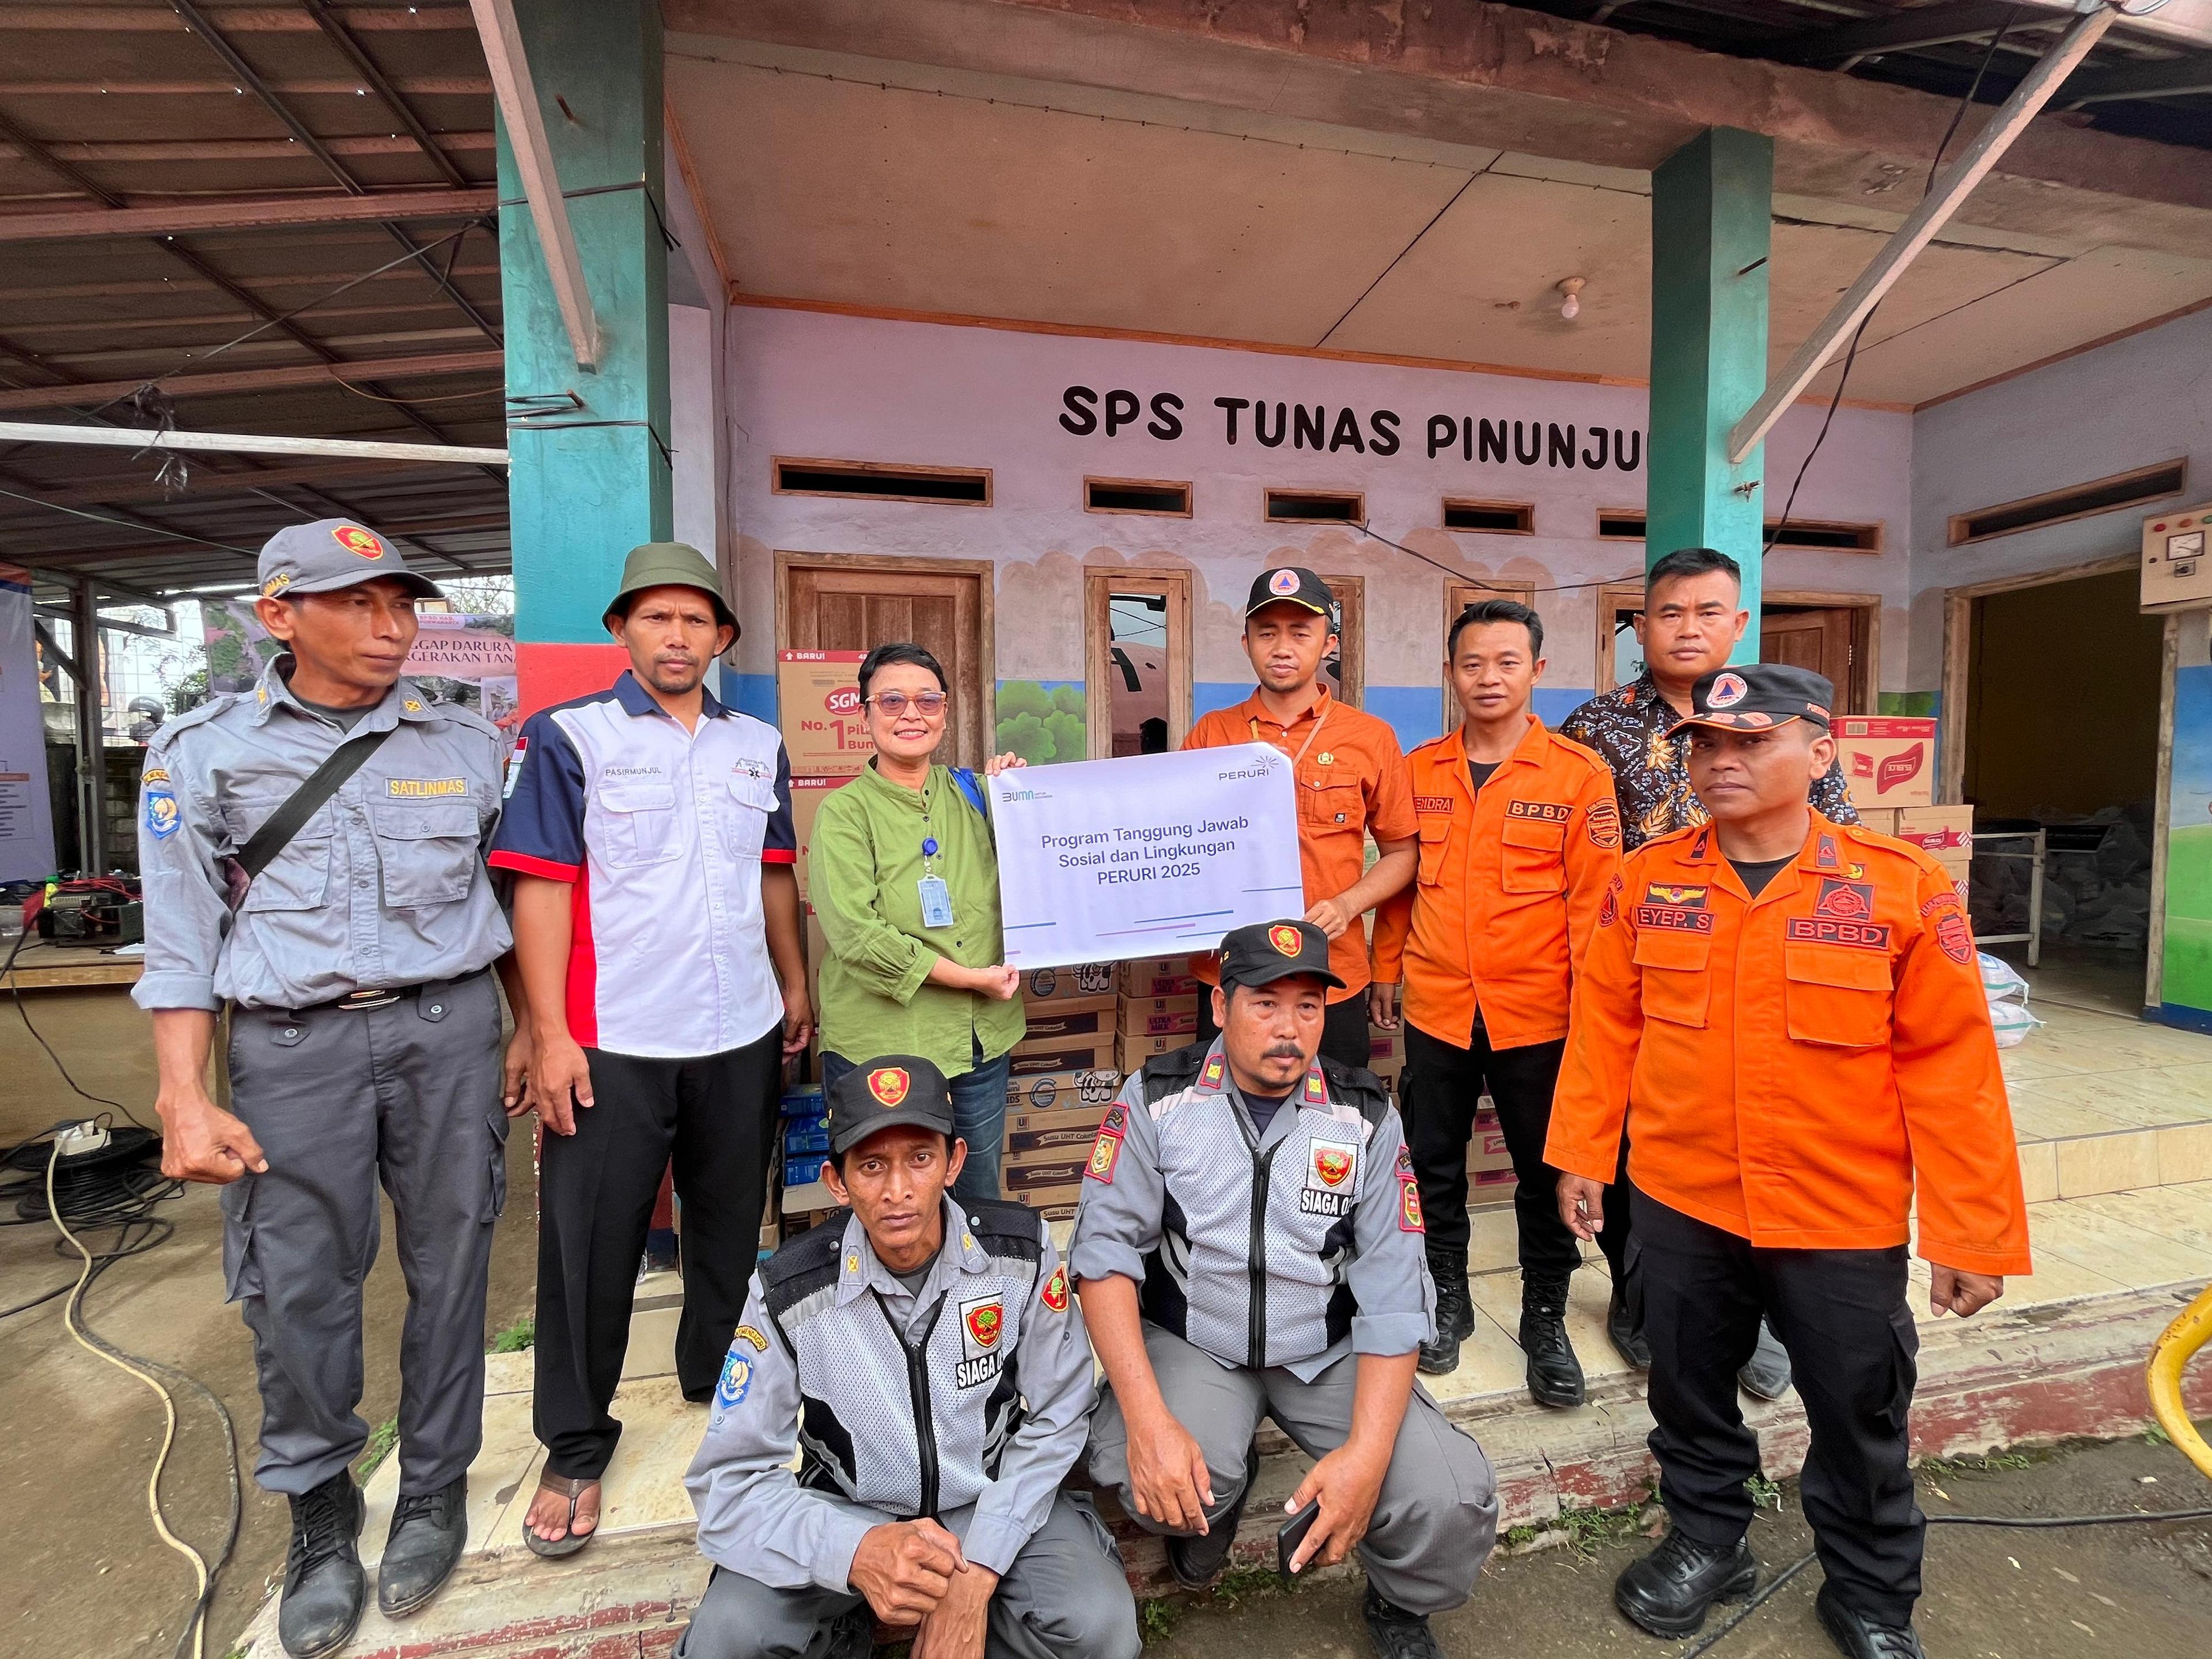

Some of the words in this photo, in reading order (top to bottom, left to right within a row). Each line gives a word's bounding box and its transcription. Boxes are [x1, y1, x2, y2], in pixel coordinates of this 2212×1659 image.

[1059, 385, 1184, 441] SPS
[1214, 397, 1400, 457] TUNAS
[1427, 414, 1649, 472] PINUNJU
[485, 653, 517, 664] TAN
[796, 652, 825, 660] BARU!
[801, 720, 827, 731] No.
[830, 720, 845, 749] 1
[605, 767, 662, 777] PASIRMUNJUL
[798, 778, 827, 786] BARU!
[1218, 768, 1269, 781] PERURI
[390, 779, 464, 796] SATLINMAS
[1002, 790, 1035, 802] BUMN
[1511, 802, 1569, 820] BPBD
[1041, 831, 1109, 849] Program
[1113, 823, 1192, 842] Tanggung
[1196, 816, 1249, 834] Jawab
[1058, 851, 1105, 868] Sosial
[1110, 849, 1139, 863] dan
[1144, 839, 1235, 861] Lingkungan
[1097, 866, 1157, 885] PERURI
[1161, 862, 1200, 879] 2025
[1639, 909, 1688, 927] EYEP.
[1696, 914, 1710, 929] S
[1794, 921, 1883, 944] BPBD
[1301, 1189, 1339, 1215] SIAGA
[957, 1354, 995, 1388] SIAGA
